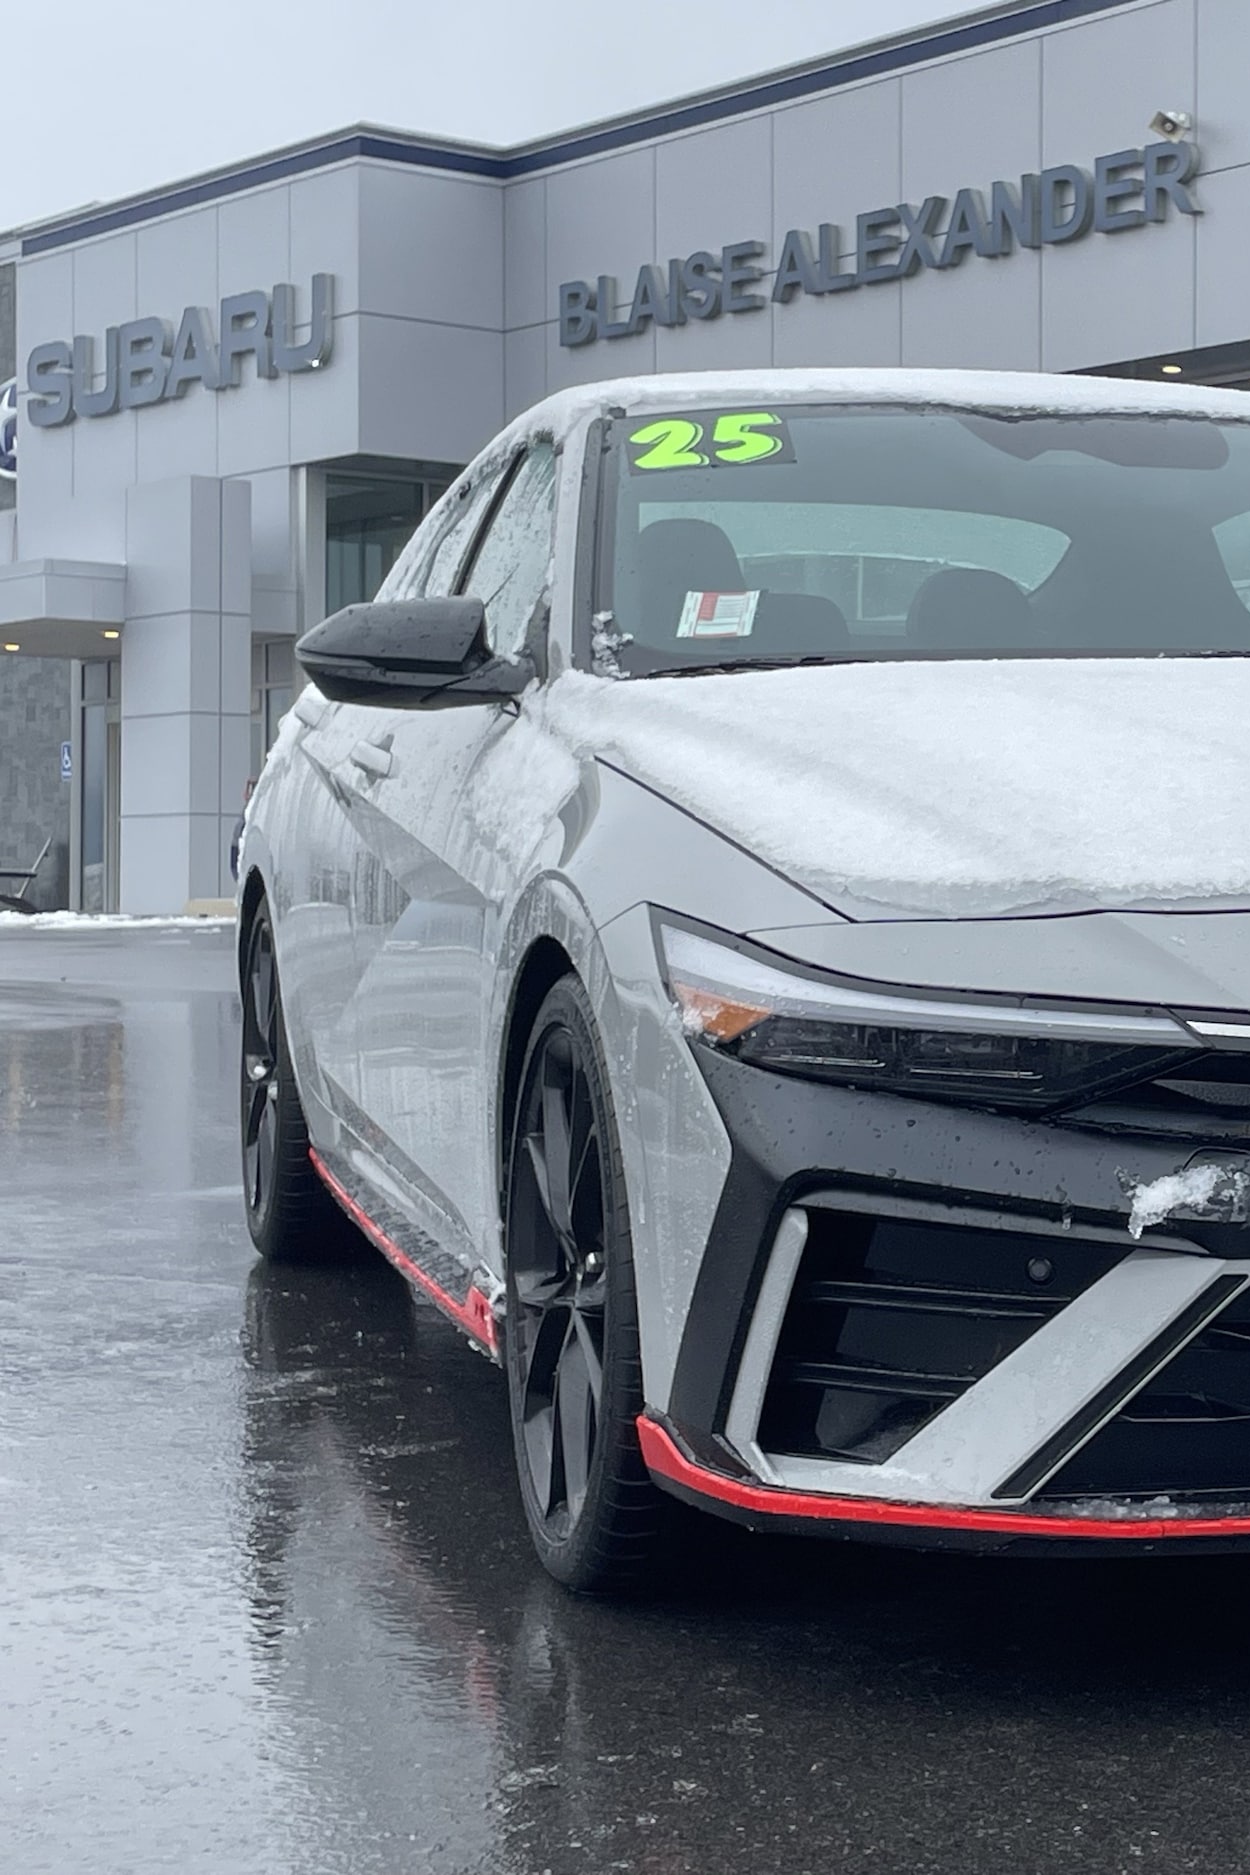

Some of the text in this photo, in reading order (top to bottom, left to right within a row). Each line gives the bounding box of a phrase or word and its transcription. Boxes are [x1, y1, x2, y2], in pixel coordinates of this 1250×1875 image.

[559, 140, 1203, 348] BLAISE ALEXANDER
[27, 272, 334, 428] SUBARU
[629, 412, 783, 470] 25
